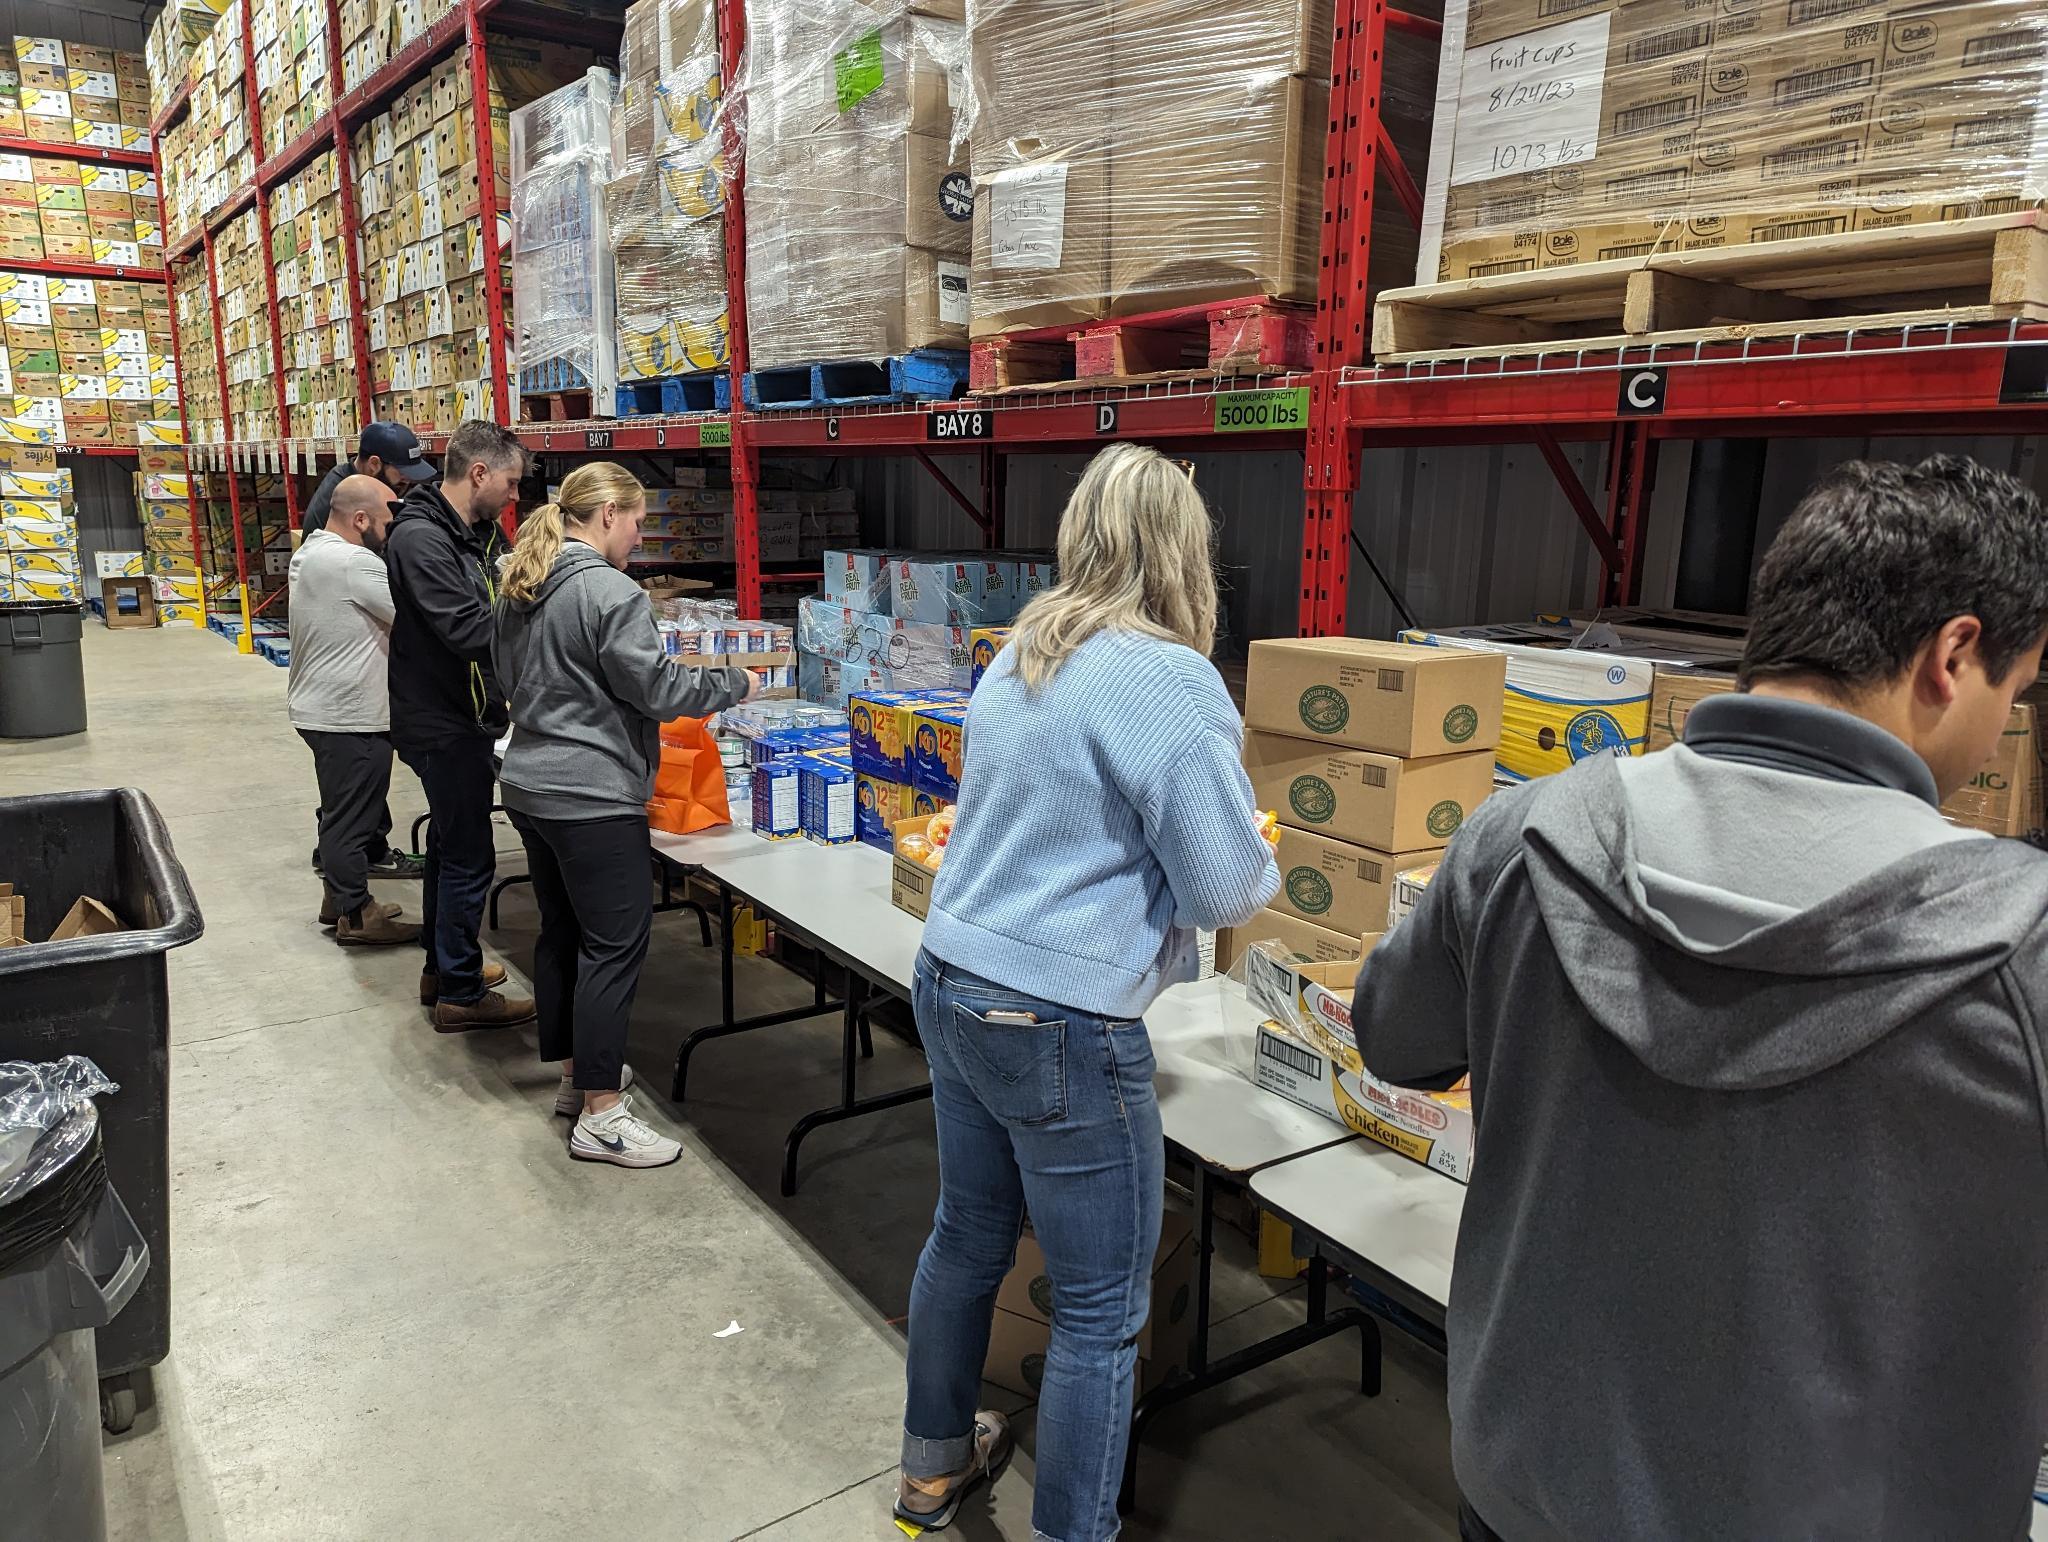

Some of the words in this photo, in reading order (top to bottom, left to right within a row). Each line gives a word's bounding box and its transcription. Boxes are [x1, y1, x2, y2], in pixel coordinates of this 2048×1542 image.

[1901, 26, 1933, 42] Dole
[1844, 34, 1878, 49] 04174
[1490, 46, 1530, 72] Fruit
[1533, 42, 1577, 63] Cups
[1672, 73, 1699, 86] 04174
[1718, 68, 1744, 81] Dole
[1489, 81, 1575, 112] 8/24/23
[491, 108, 509, 118] Pre
[1830, 114, 1862, 128] 04174
[1492, 143, 1546, 172] 1073
[1557, 139, 1584, 163] lbs
[1768, 216, 1789, 224] PRODUIT
[1863, 217, 1881, 226] SALADE
[1882, 216, 1893, 224] AUX
[1894, 213, 1912, 222] FRUITS
[1514, 238, 1537, 249] 04174
[1553, 235, 1576, 247] Dole
[1685, 240, 1701, 248] SALADE
[1710, 236, 1725, 244] FRUITS
[1627, 372, 1658, 408] C
[1228, 394, 1260, 403] MAXIMUM
[1261, 391, 1297, 401] CAPACITY
[1100, 406, 1114, 430] D
[1220, 405, 1268, 425] 5000
[1272, 404, 1298, 423] lbs
[828, 419, 837, 437] C
[937, 414, 971, 436] BAY
[972, 413, 982, 435] 8
[544, 435, 550, 448] C
[589, 433, 604, 447] BAY
[604, 432, 609, 446] 7
[658, 430, 664, 445] D
[702, 431, 719, 443] 5000
[719, 430, 730, 442] lbs
[56, 446, 76, 454] BAY
[845, 571, 860, 583] REAL
[955, 578, 973, 588] REAL
[986, 575, 1004, 585] REAL
[1027, 578, 1042, 586] REAL
[846, 581, 861, 592] FRUIT
[900, 582, 918, 592] REAL
[955, 586, 972, 595] FRUIT
[986, 582, 1005, 592] FRUIT
[900, 591, 919, 601] FRUIT
[845, 624, 911, 669] 620
[950, 647, 971, 658] REAL
[951, 656, 972, 667] FRUIT
[1610, 670, 1623, 681] W
[1304, 688, 1331, 705] NATURE'S
[1331, 692, 1346, 711] PATH
[872, 710, 886, 731] 12
[938, 727, 953, 752] 12
[876, 785, 889, 807] 12
[1292, 780, 1319, 793] NATURE'S
[1319, 784, 1334, 801] PATH
[1450, 803, 1461, 817] PATH
[1289, 870, 1316, 883] NATURE'S
[1316, 875, 1330, 892] PATH
[1344, 1103, 1400, 1147] Chicken
[1400, 1116, 1430, 1137] Noodles
[1439, 1157, 1457, 1174] 85g
